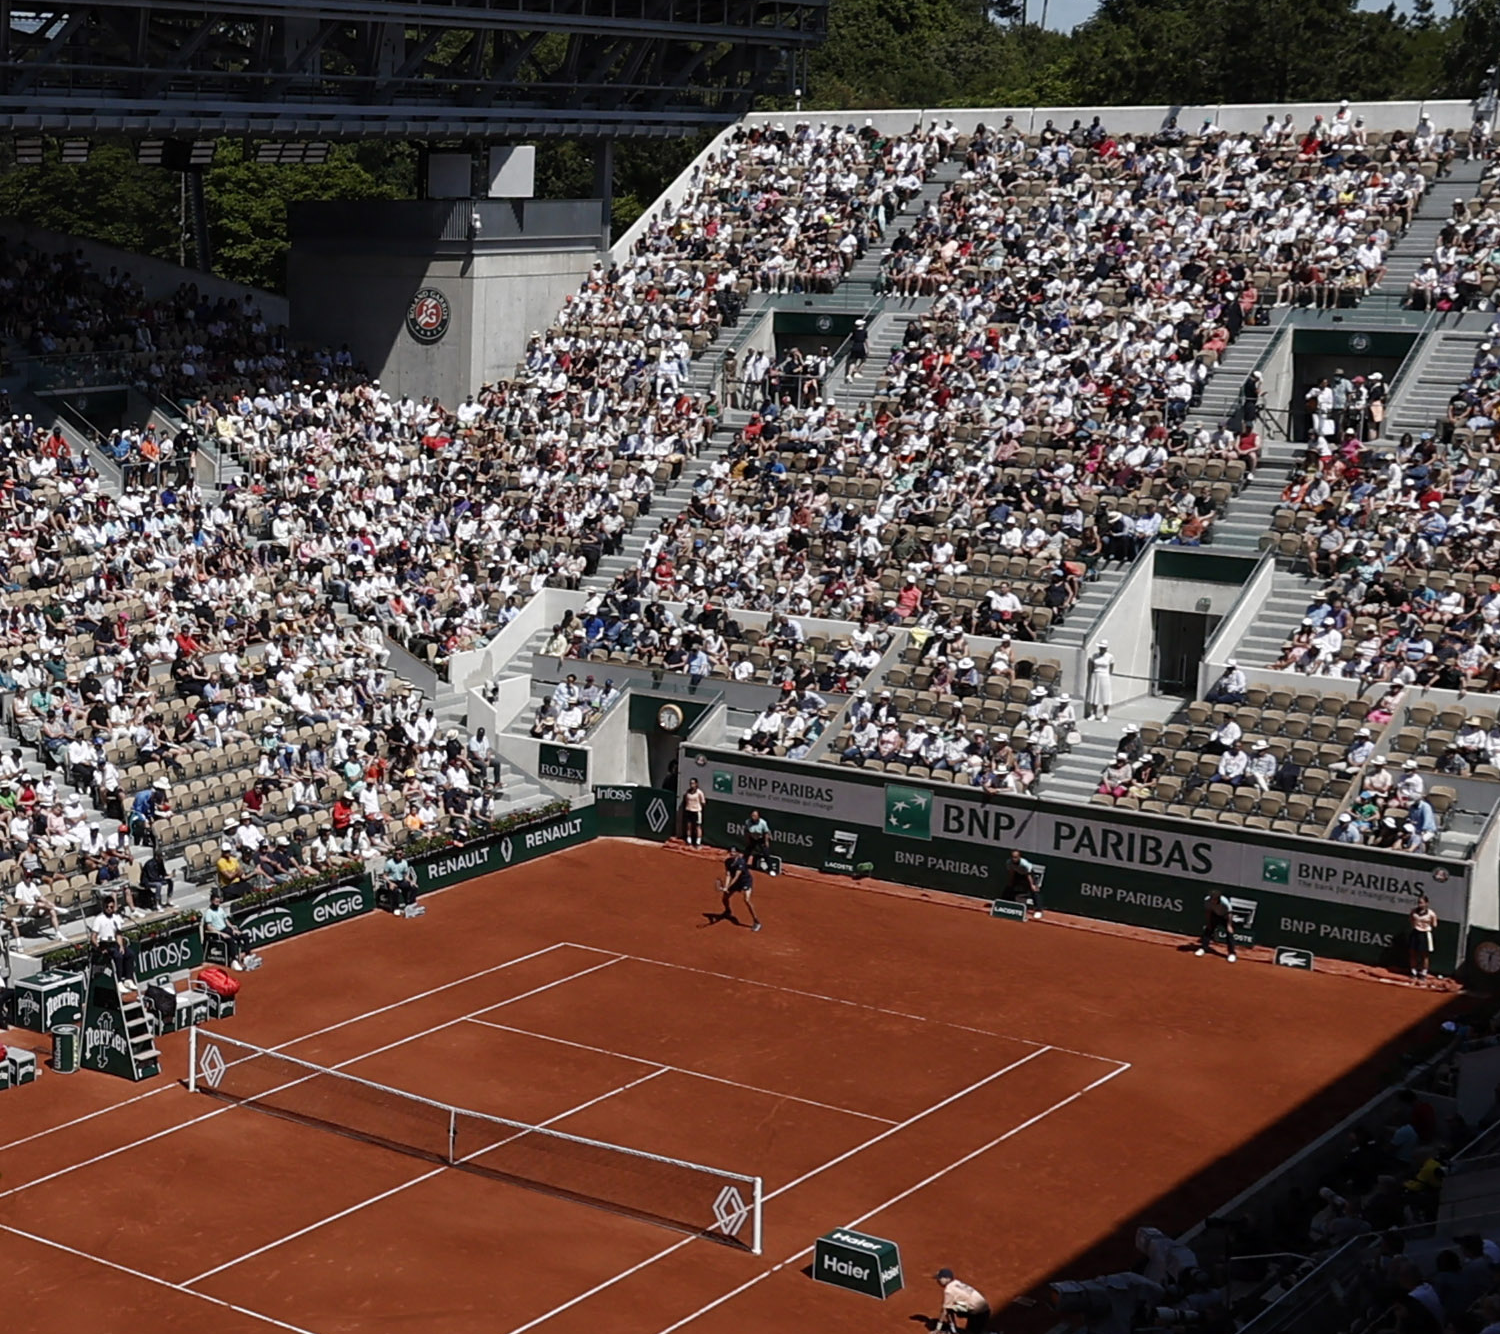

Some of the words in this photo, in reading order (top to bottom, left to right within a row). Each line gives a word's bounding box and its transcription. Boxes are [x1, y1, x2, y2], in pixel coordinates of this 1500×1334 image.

[540, 763, 585, 780] ROLEX
[597, 787, 633, 802] Infosys
[737, 773, 769, 792] BNP
[771, 779, 834, 803] PARIBAS
[525, 818, 583, 849] RENAULT
[942, 803, 1016, 841] BNP
[1053, 820, 1213, 875] PARIBAS
[428, 847, 490, 880] RENAULT
[824, 860, 855, 872] LACOSTE
[894, 850, 925, 869] BNP
[927, 855, 989, 879] PARIBAS
[1297, 863, 1337, 882] BNP
[1341, 869, 1425, 898] PARIBAS
[994, 905, 1024, 917] LACOSTE
[1081, 881, 1113, 901] BNP
[1115, 888, 1184, 913] PARIBAS
[1280, 917, 1316, 934] BNP
[1319, 923, 1394, 948] PARIBAS
[138, 936, 191, 974] Infosys
[46, 987, 81, 1028] perrier
[85, 1026, 128, 1060] perrier
[832, 1232, 883, 1250] Haier
[823, 1254, 871, 1281] Haier
[880, 1264, 900, 1284] Haier
